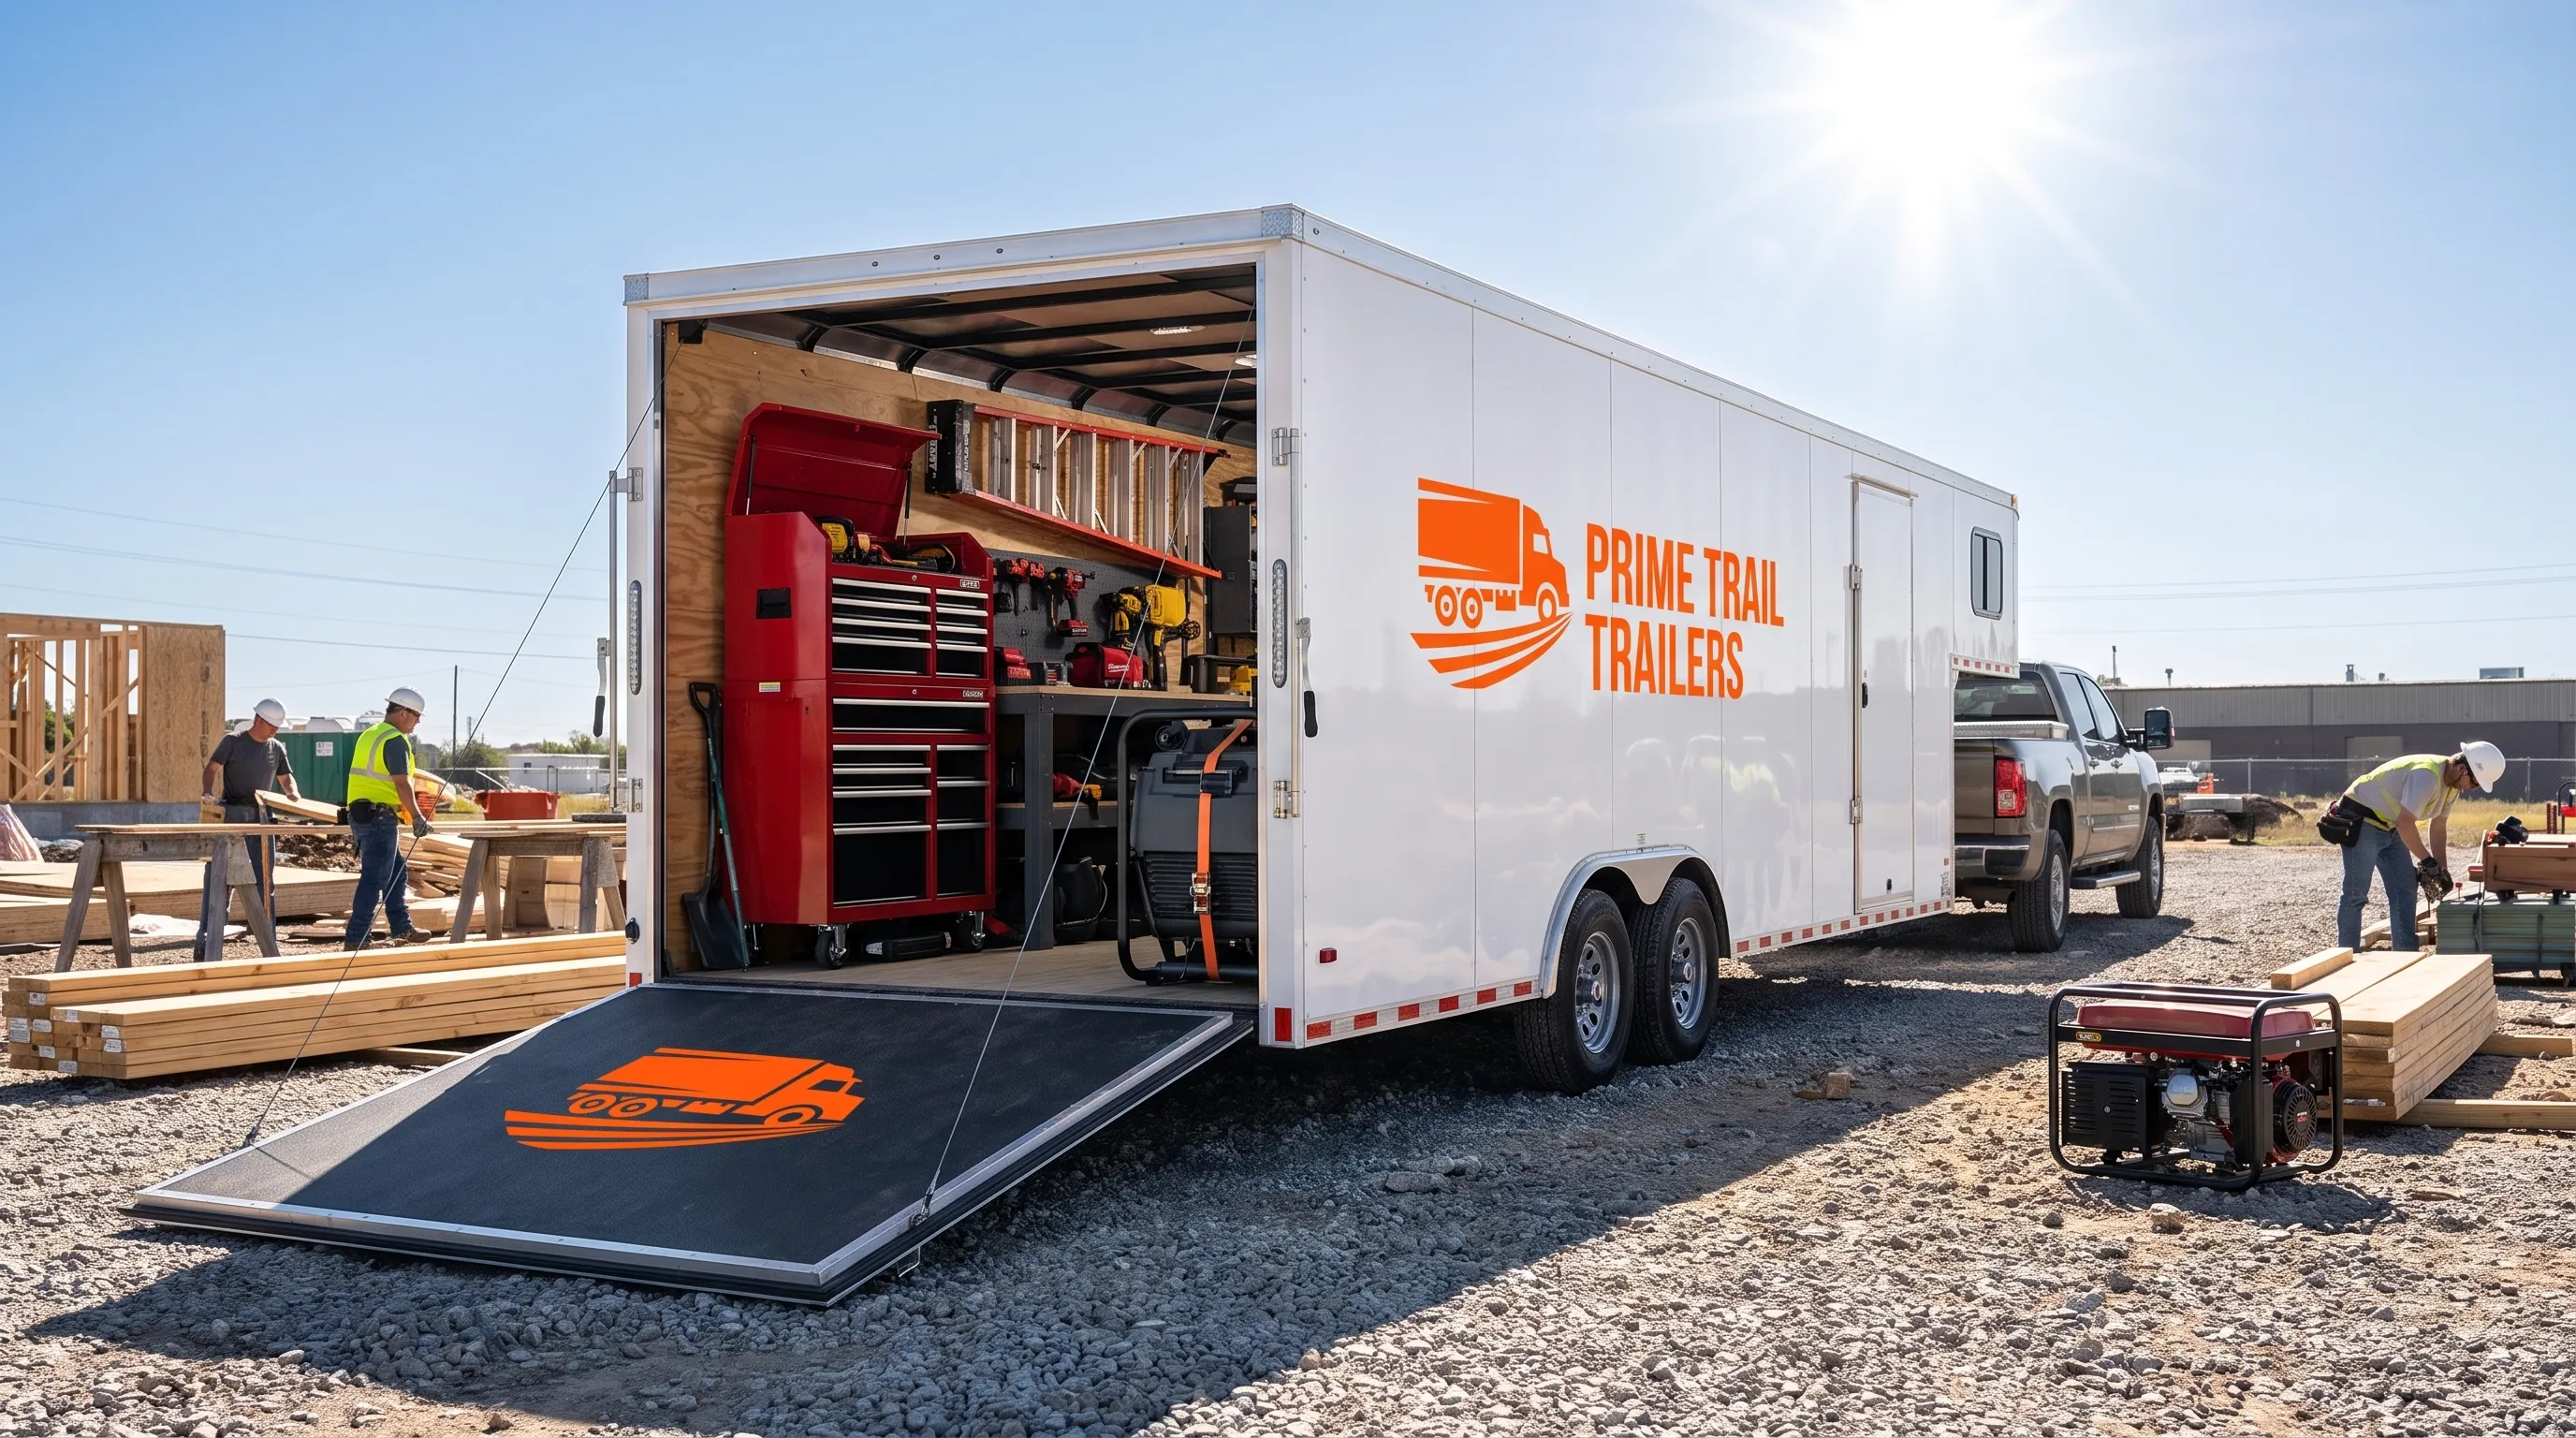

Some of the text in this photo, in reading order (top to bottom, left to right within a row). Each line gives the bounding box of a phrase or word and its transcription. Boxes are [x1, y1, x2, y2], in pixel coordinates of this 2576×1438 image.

[1587, 522, 1785, 627] PRIME TRAIL
[1585, 613, 1744, 700] TRAILERS
